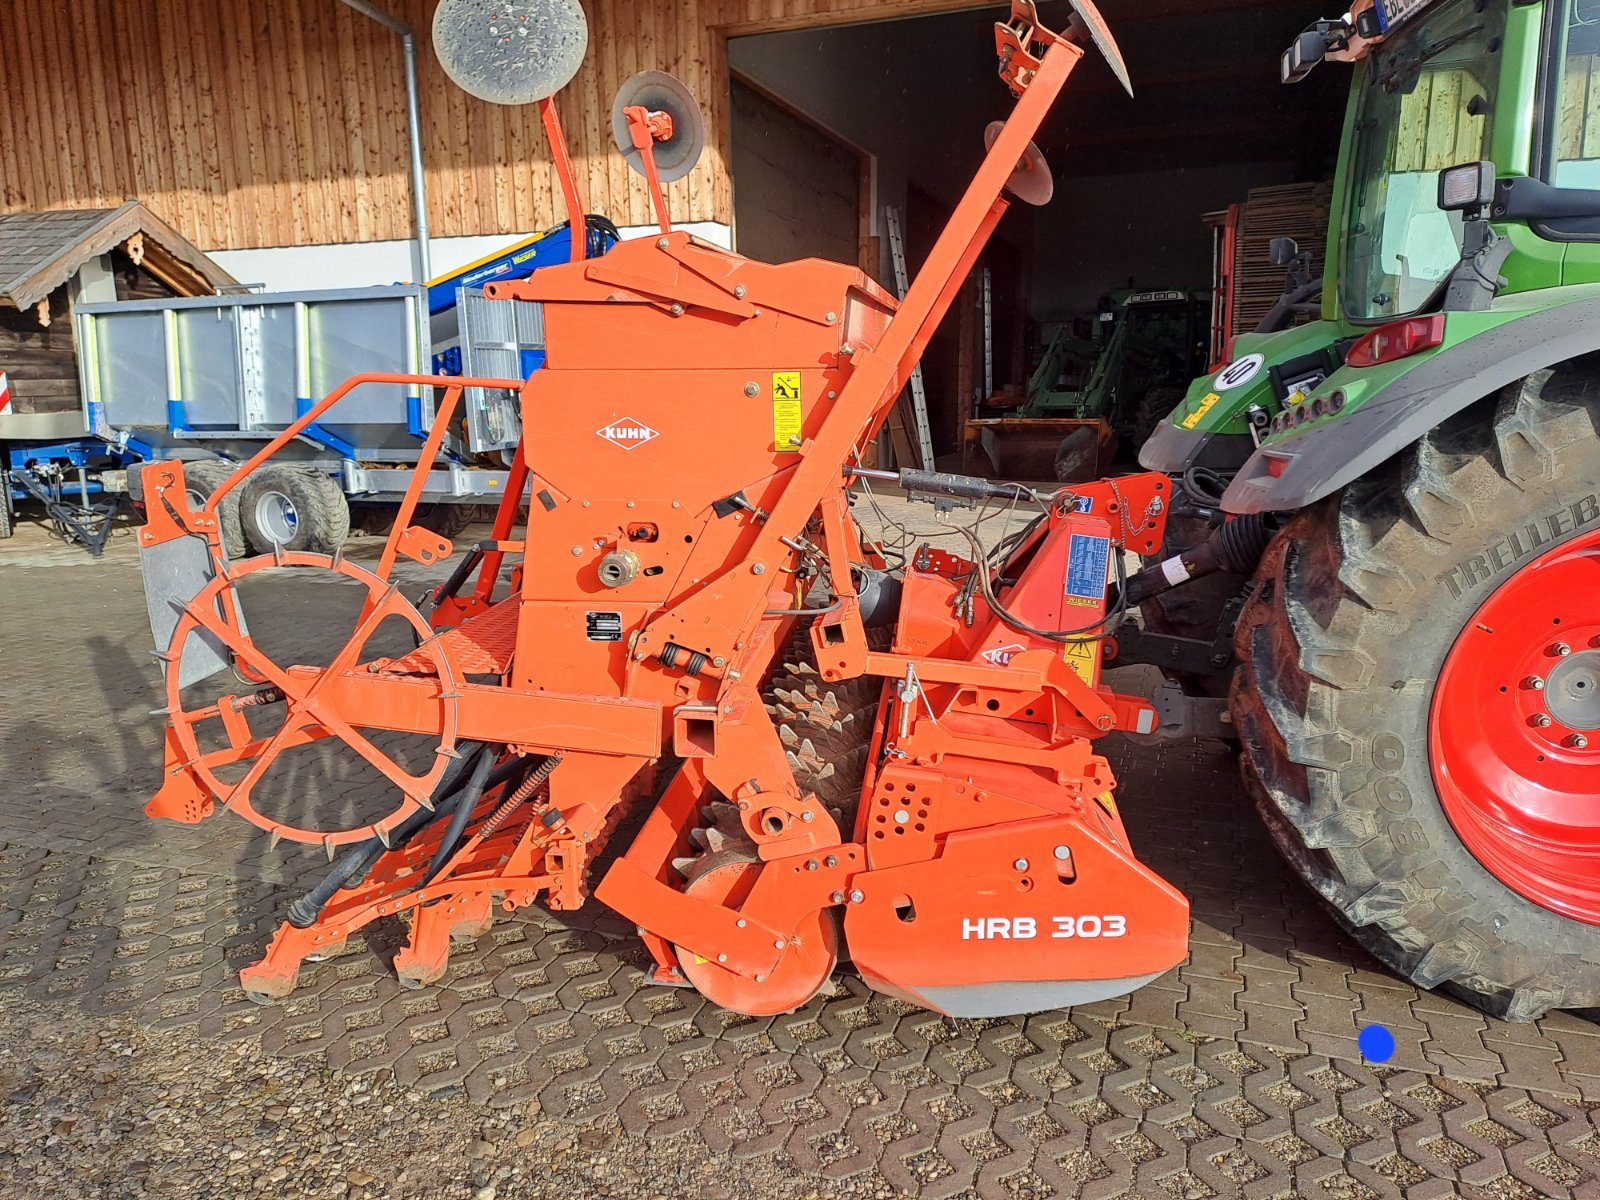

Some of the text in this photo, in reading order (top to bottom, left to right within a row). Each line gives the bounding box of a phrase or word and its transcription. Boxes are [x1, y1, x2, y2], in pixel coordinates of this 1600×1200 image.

[1222, 358, 1257, 384] 40
[604, 427, 650, 439] KUHN
[1434, 494, 1600, 600] TRELLEB
[990, 650, 1014, 664] KU
[962, 915, 1127, 940] HRB 303
